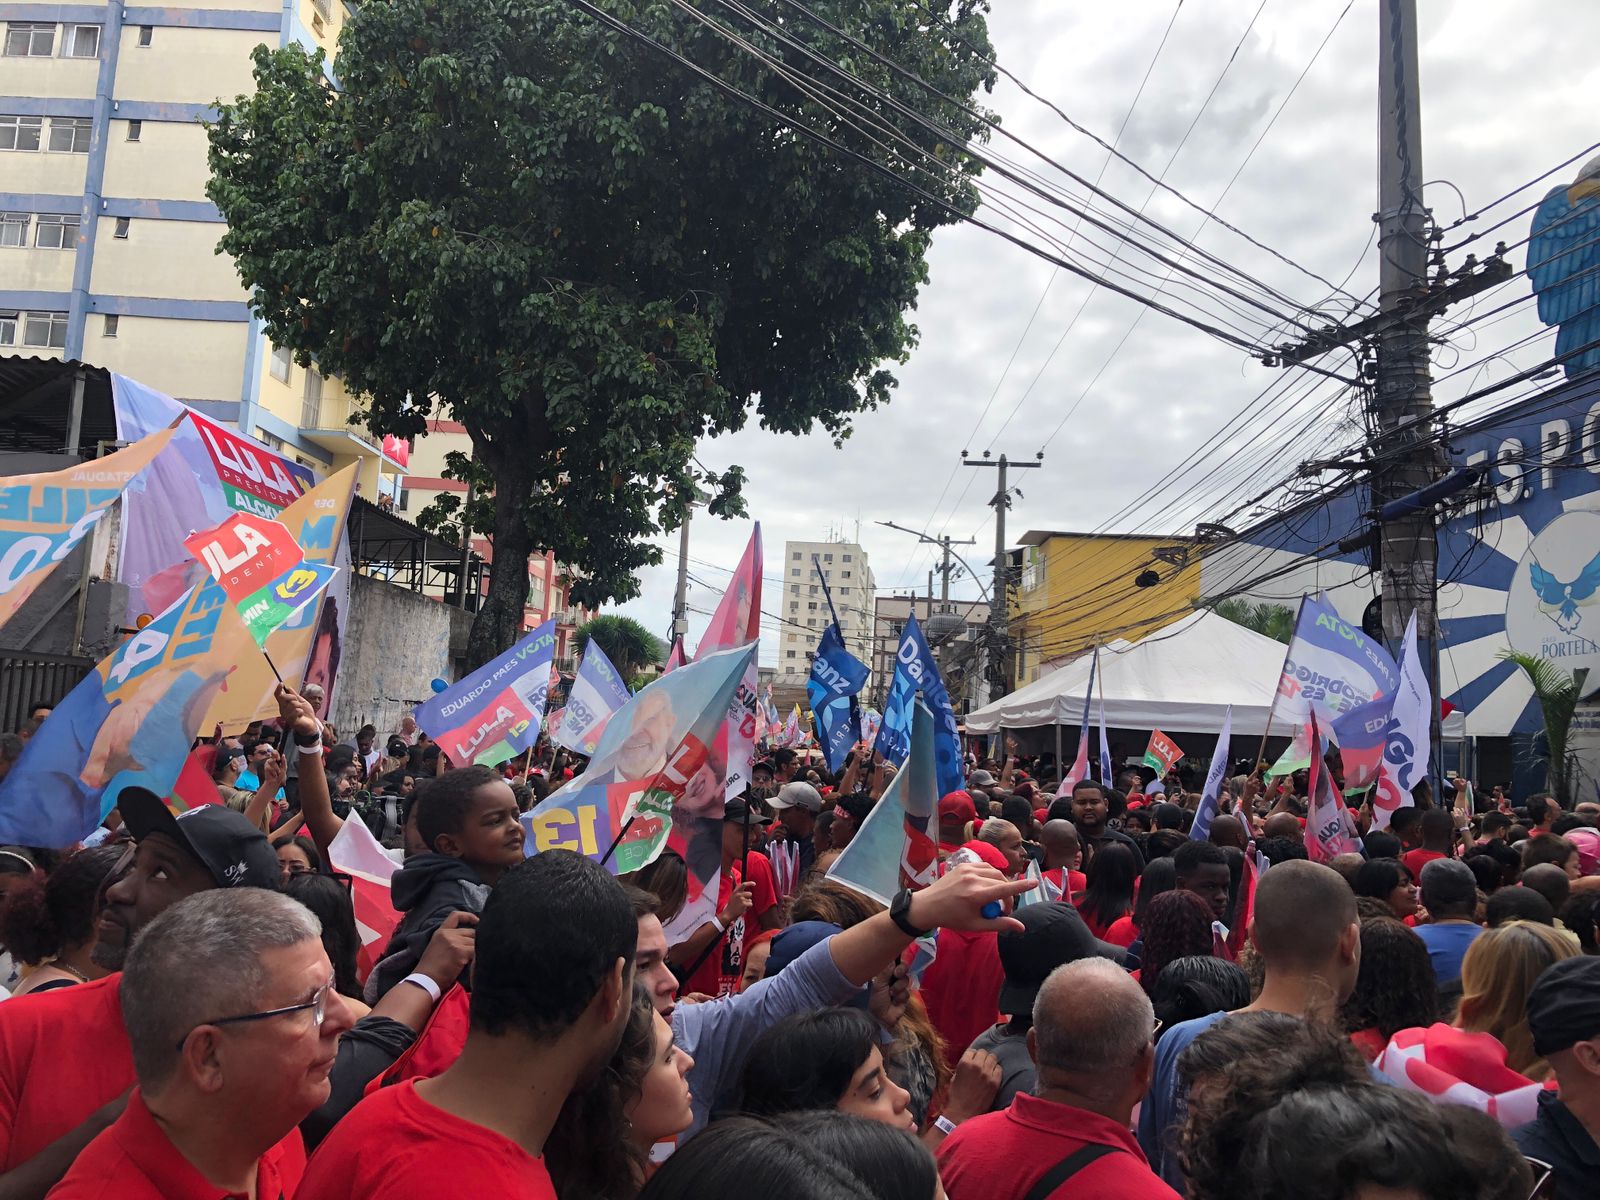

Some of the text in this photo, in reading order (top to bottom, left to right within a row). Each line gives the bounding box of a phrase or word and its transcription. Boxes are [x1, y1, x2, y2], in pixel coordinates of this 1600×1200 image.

[201, 425, 300, 498] LULA
[1542, 639, 1597, 658] PORTELA
[440, 632, 555, 718] EDUARDO PAES VOTA
[455, 705, 515, 760] LULA
[508, 719, 530, 738] 13
[1153, 737, 1174, 762] LULA
